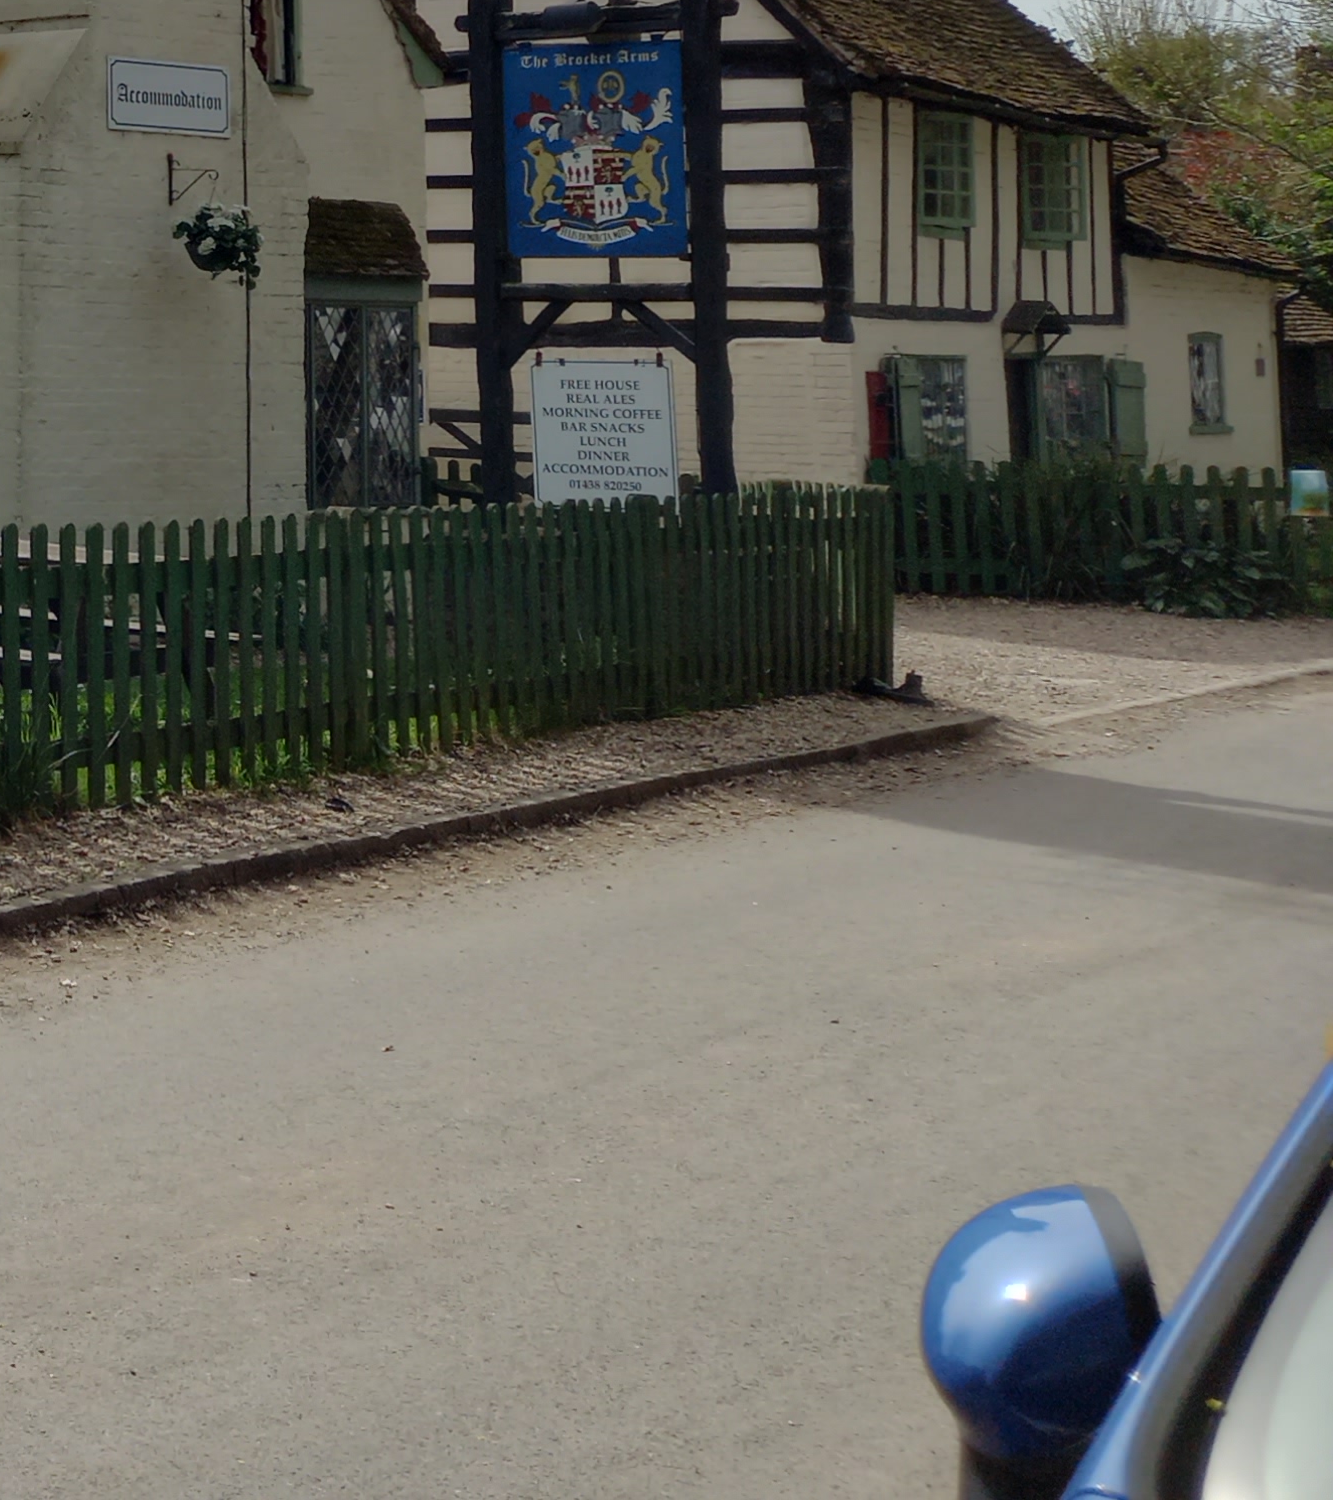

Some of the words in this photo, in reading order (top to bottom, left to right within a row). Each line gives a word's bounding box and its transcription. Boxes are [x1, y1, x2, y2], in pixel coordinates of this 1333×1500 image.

[520, 55, 549, 68] The
[554, 52, 611, 67] Brocket
[616, 49, 659, 64] Arms
[116, 82, 222, 111] Accommodation
[560, 379, 591, 390] FREE
[594, 379, 641, 391] HOUSE
[566, 393, 600, 404] REAL
[603, 394, 636, 405] ALES
[542, 407, 609, 419] MORNING
[613, 408, 663, 420] COFFEE
[560, 421, 587, 432] BAR
[590, 422, 645, 434] SNACKS
[580, 436, 627, 447] LUNCH
[577, 450, 631, 462] DINNER
[542, 463, 669, 478] ACCOMMODATION
[569, 479, 601, 490] 01438
[604, 481, 642, 491] 820250
